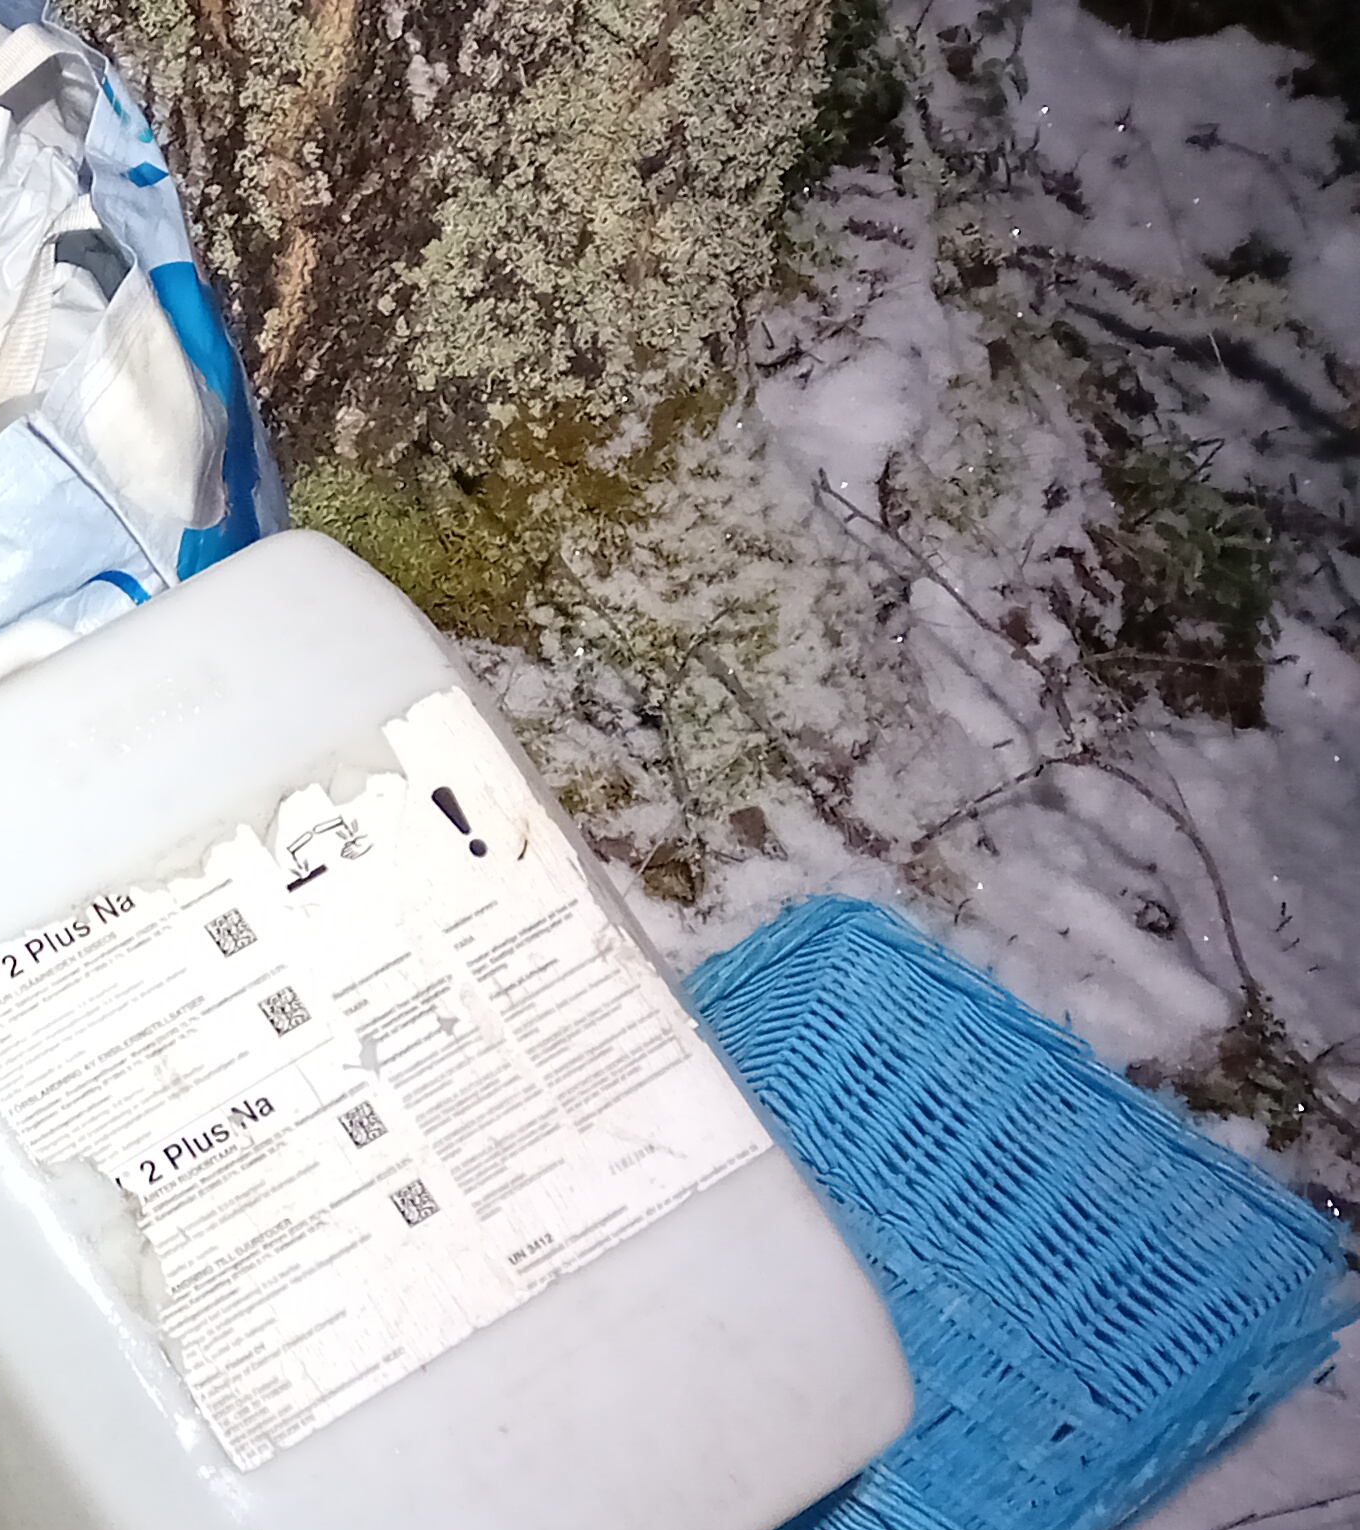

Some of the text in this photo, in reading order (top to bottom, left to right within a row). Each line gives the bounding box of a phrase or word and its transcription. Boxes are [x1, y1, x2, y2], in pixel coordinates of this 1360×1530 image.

[2, 955, 23, 978] 2
[25, 922, 90, 963] Plus
[92, 896, 134, 923] Na
[140, 1161, 162, 1183] 2
[163, 1124, 229, 1169] Plus
[233, 1098, 274, 1129] Na
[508, 1232, 554, 1266] UN 3412
